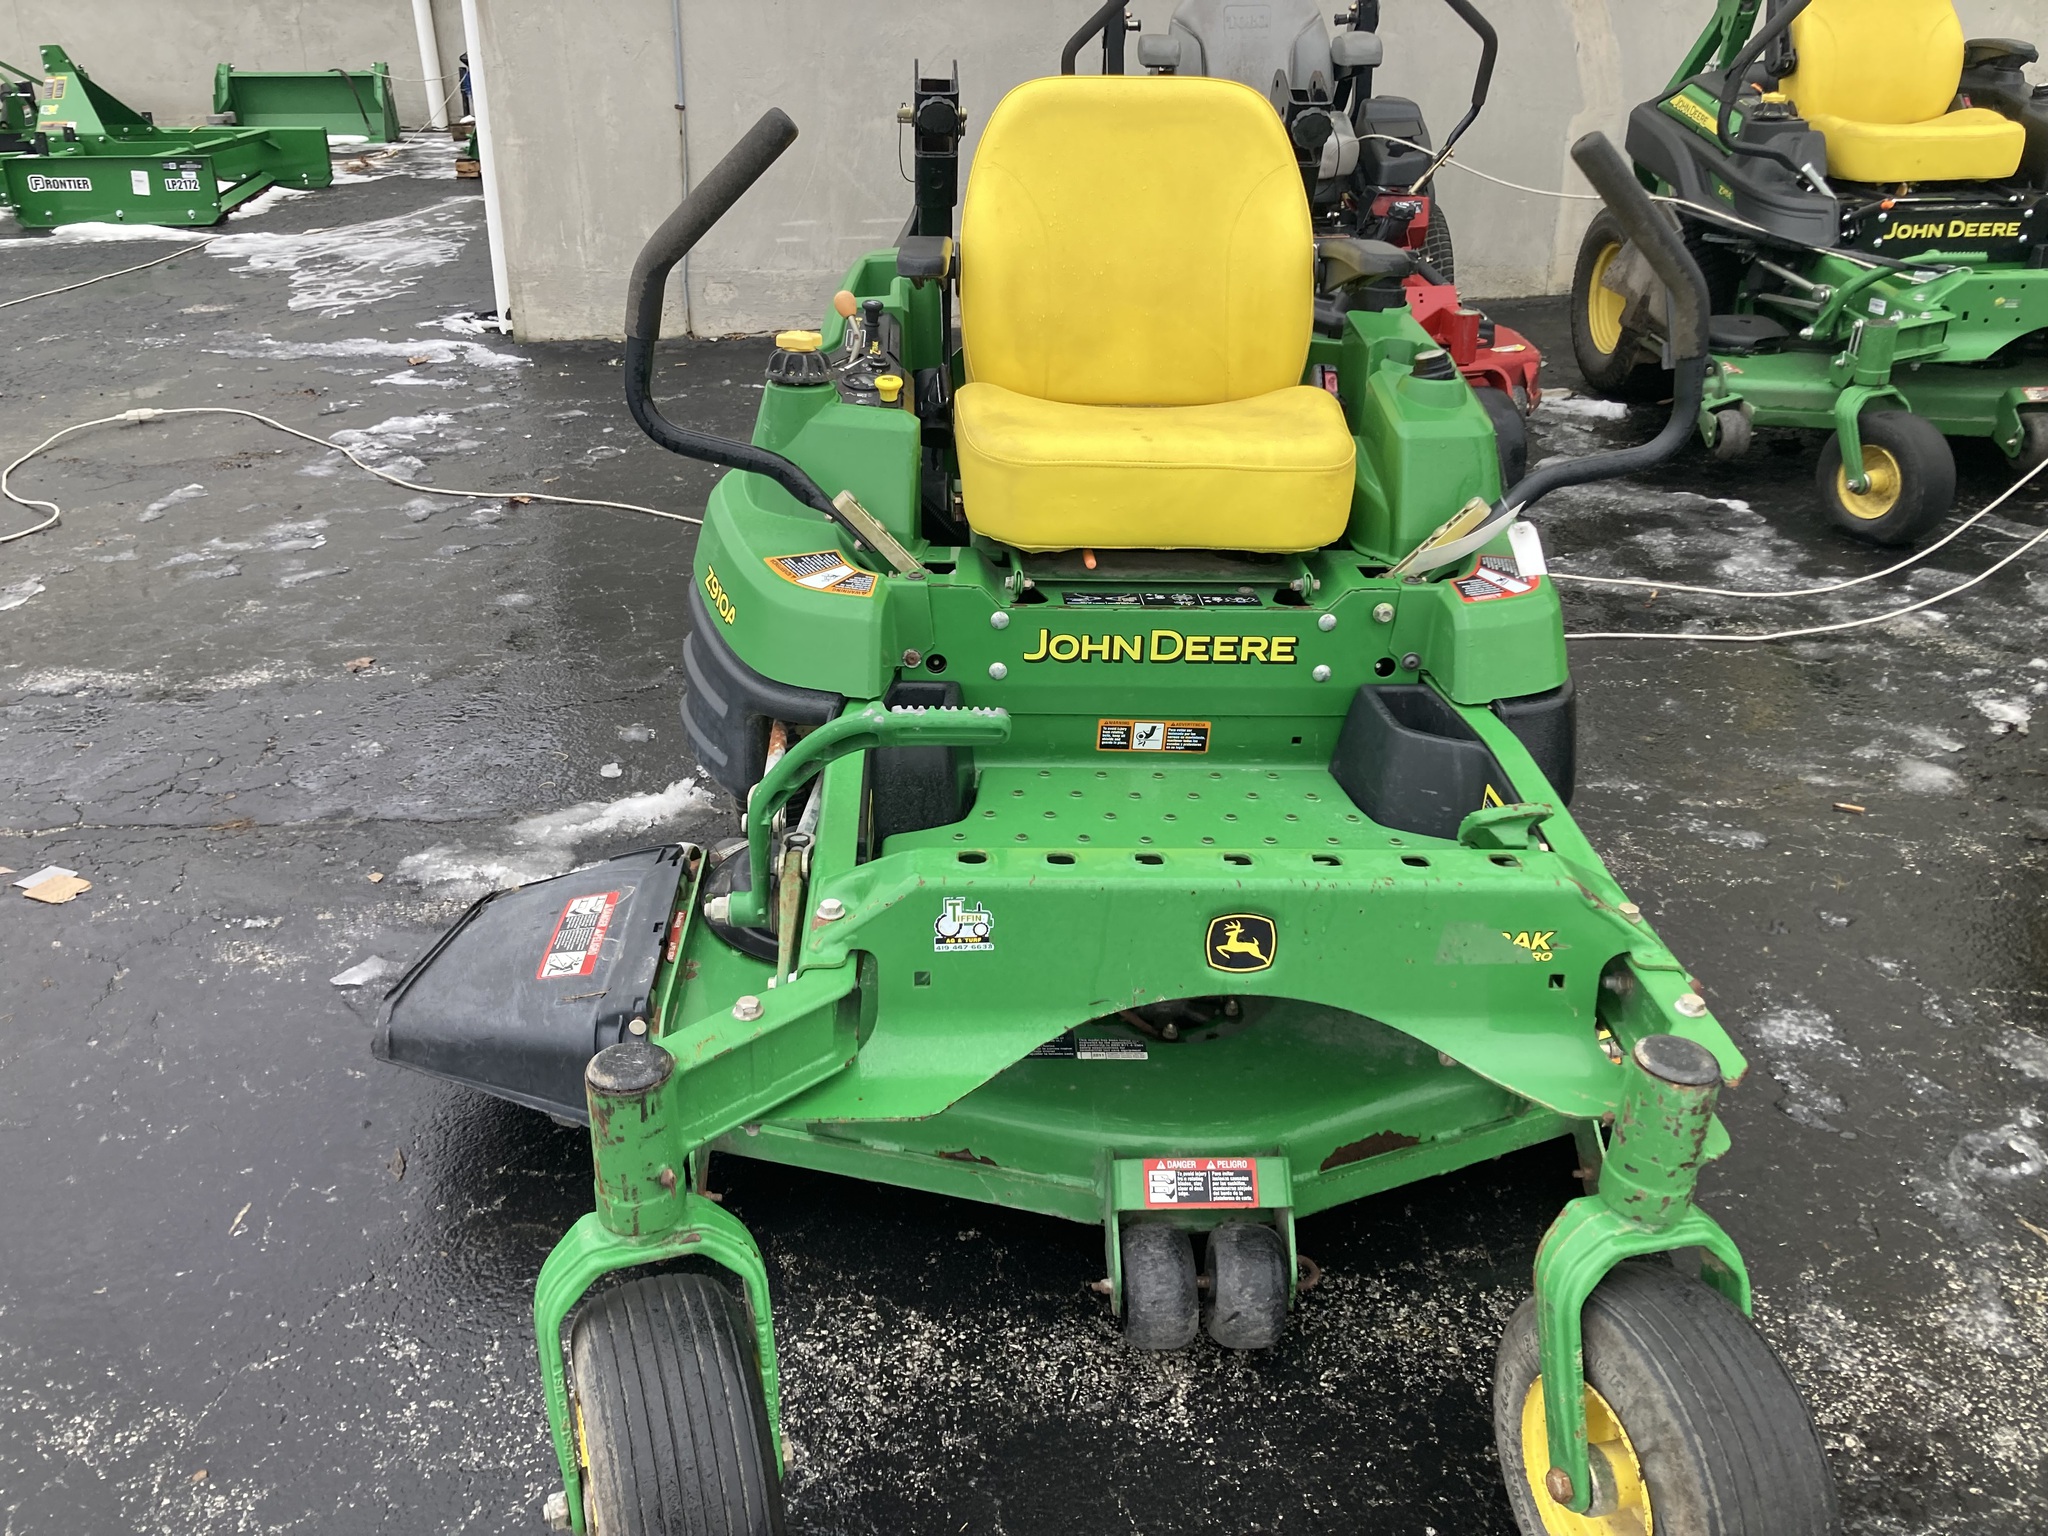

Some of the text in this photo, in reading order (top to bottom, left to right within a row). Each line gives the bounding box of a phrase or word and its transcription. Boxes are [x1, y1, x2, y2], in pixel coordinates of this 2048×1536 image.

[1675, 98, 1708, 124] JOHN DEERE
[30, 176, 90, 190] FRONTIER
[166, 179, 199, 190] LP2172
[1883, 220, 2021, 240] JOHN DEERE
[704, 563, 736, 626] Z910A
[1023, 628, 1298, 664] JOHN DEERE
[948, 902, 982, 922] TIFFIN
[1167, 1160, 1248, 1168] DANGER PELIGRO
